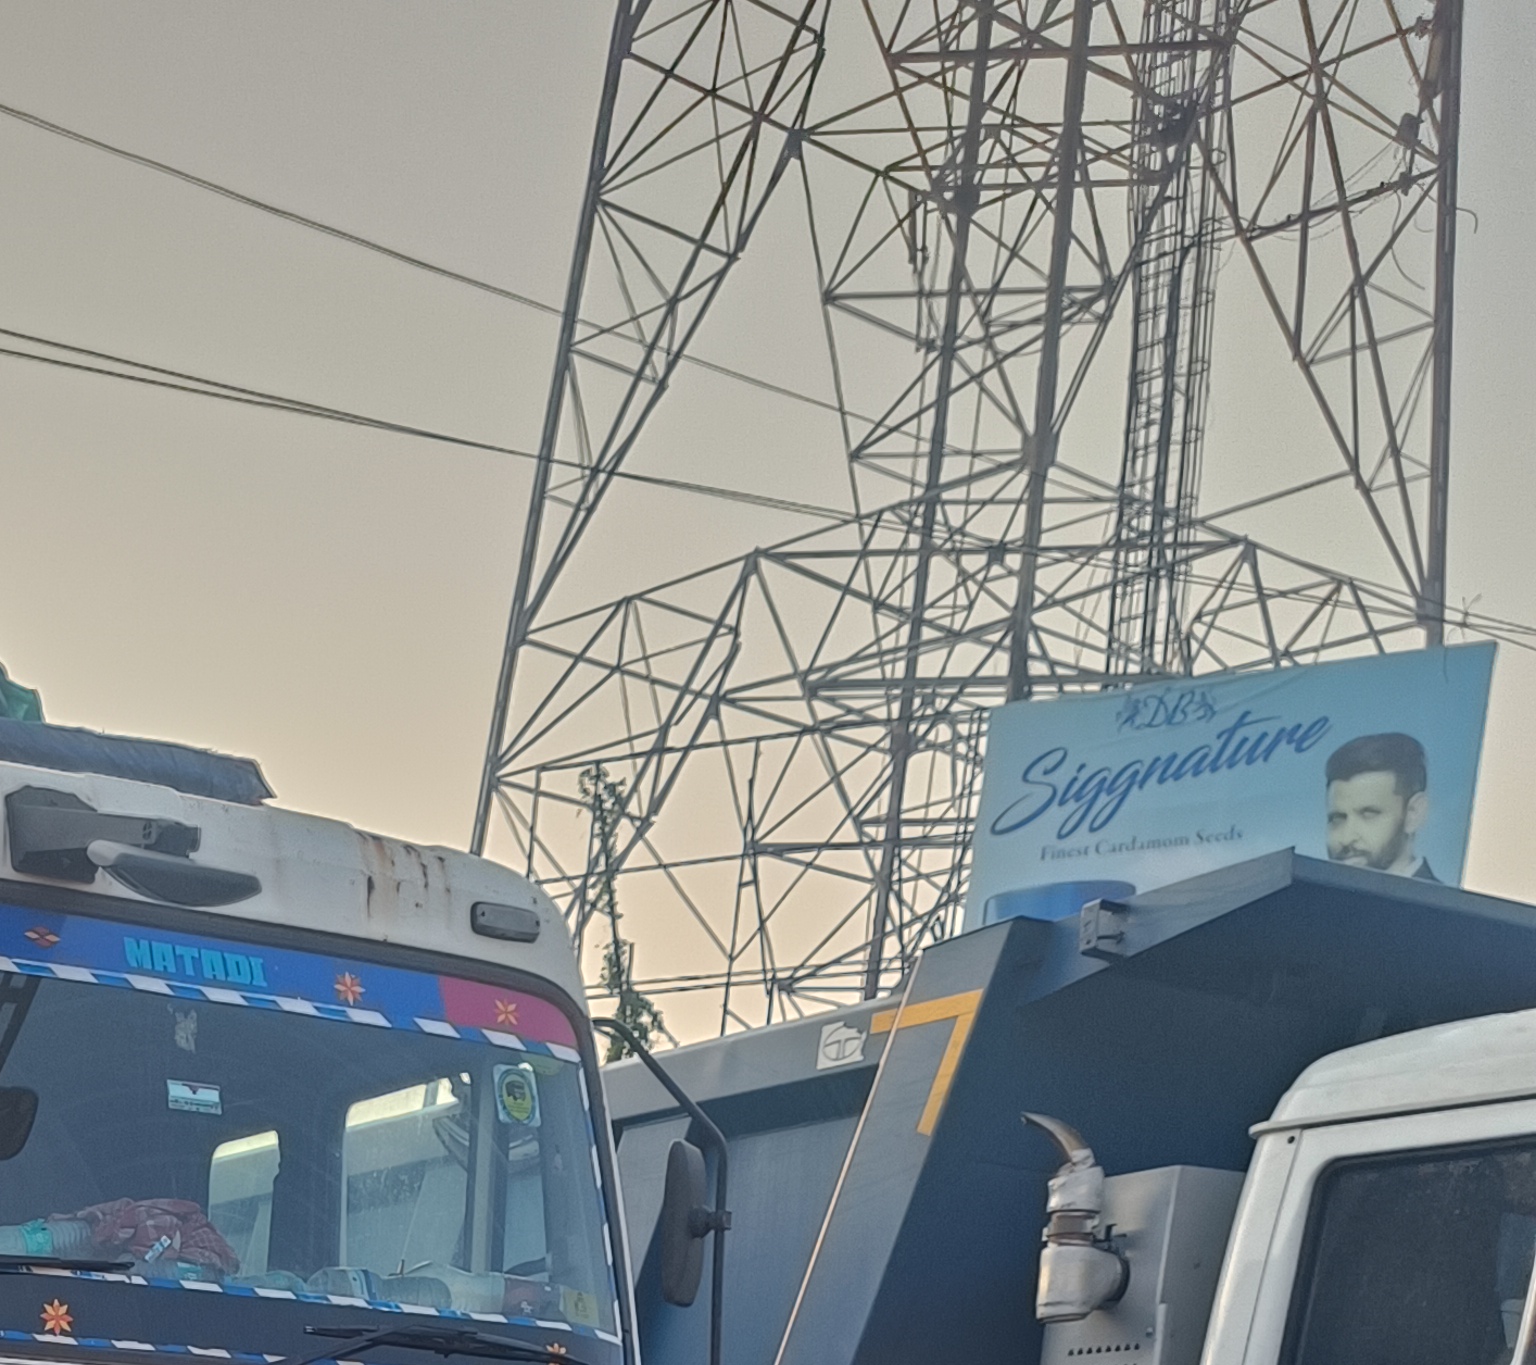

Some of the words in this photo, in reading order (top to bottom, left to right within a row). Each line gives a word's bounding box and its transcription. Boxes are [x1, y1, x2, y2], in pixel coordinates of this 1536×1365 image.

[990, 709, 1331, 840] Siggnature
[1039, 844, 1090, 862] Finest
[1094, 835, 1191, 856] Cardamom
[1194, 824, 1245, 846] Seeds
[122, 935, 269, 988] MATADI
